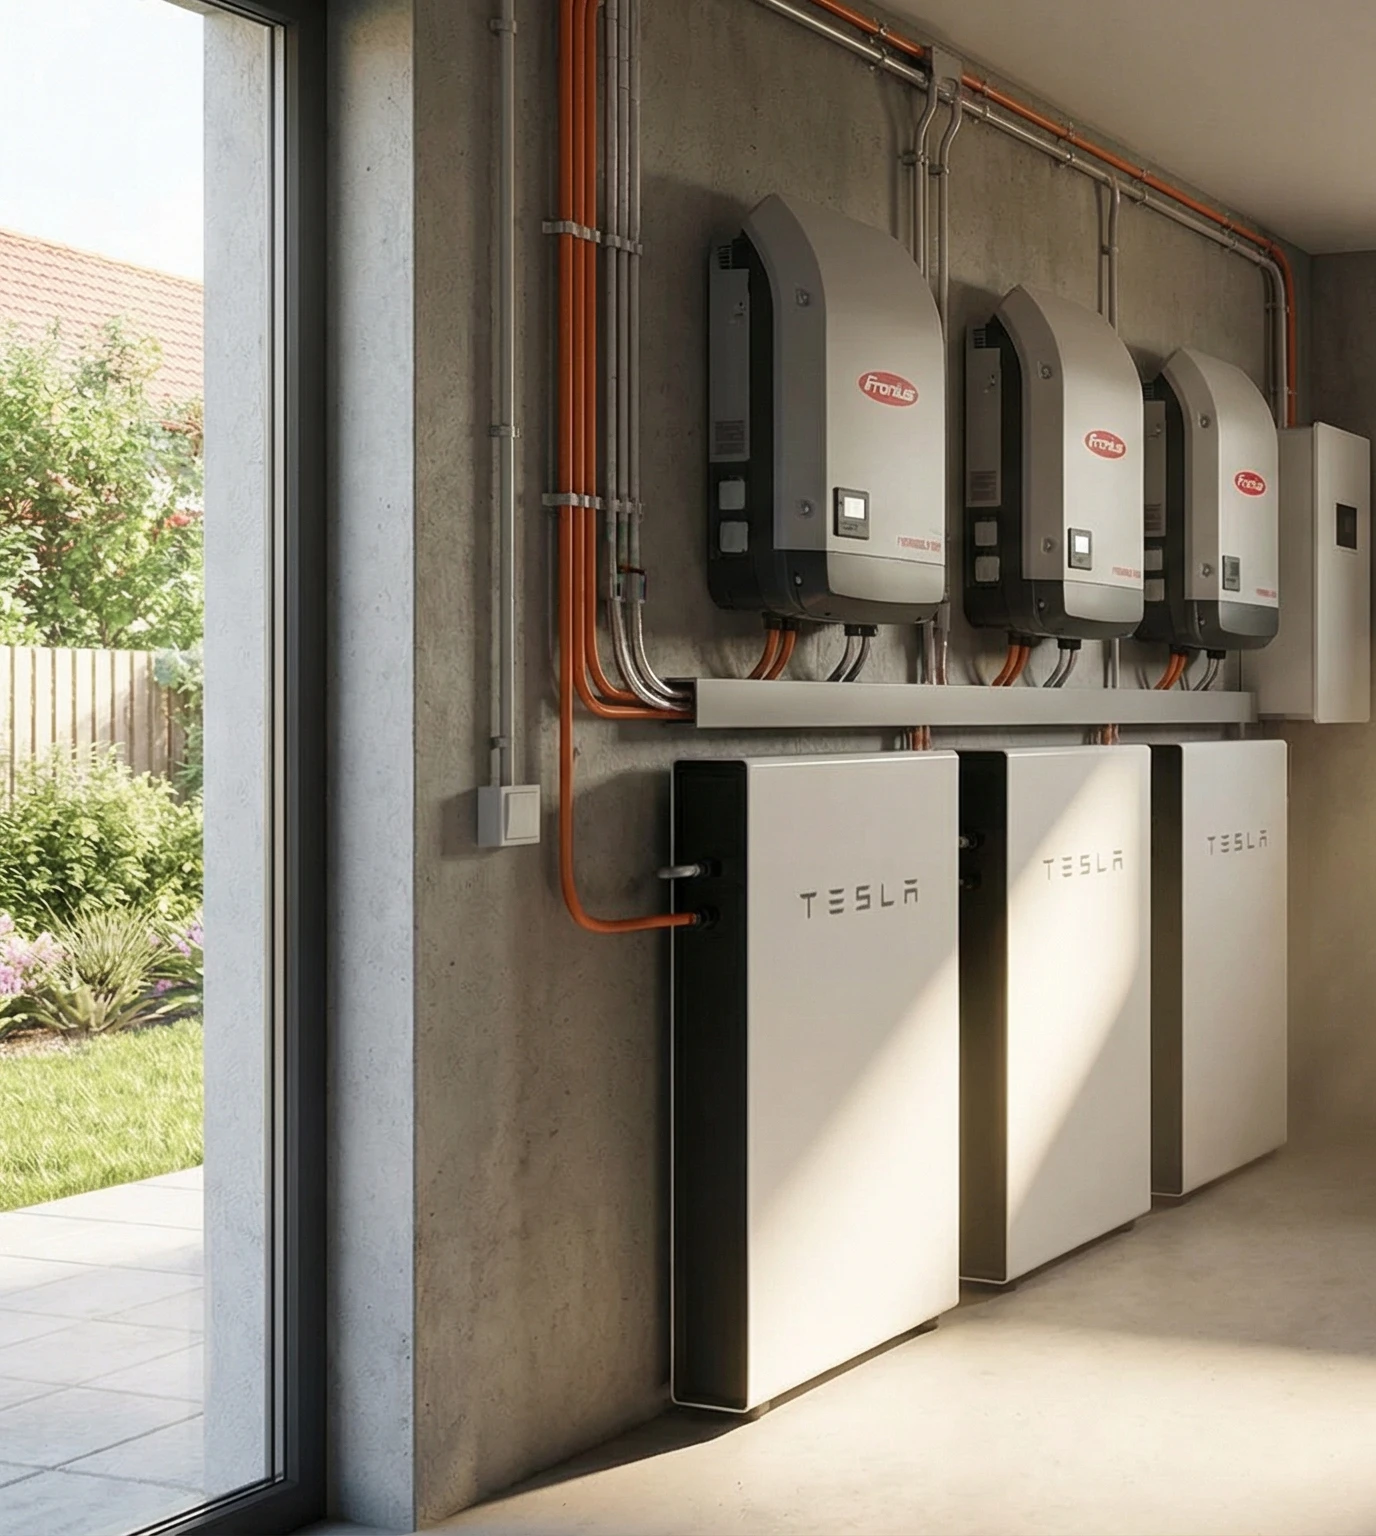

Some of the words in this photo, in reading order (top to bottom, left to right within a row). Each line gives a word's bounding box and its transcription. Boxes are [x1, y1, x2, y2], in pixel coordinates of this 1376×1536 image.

[1207, 829, 1268, 856] TESLA
[1043, 849, 1123, 881] TESLA
[799, 879, 918, 919] TESLA
